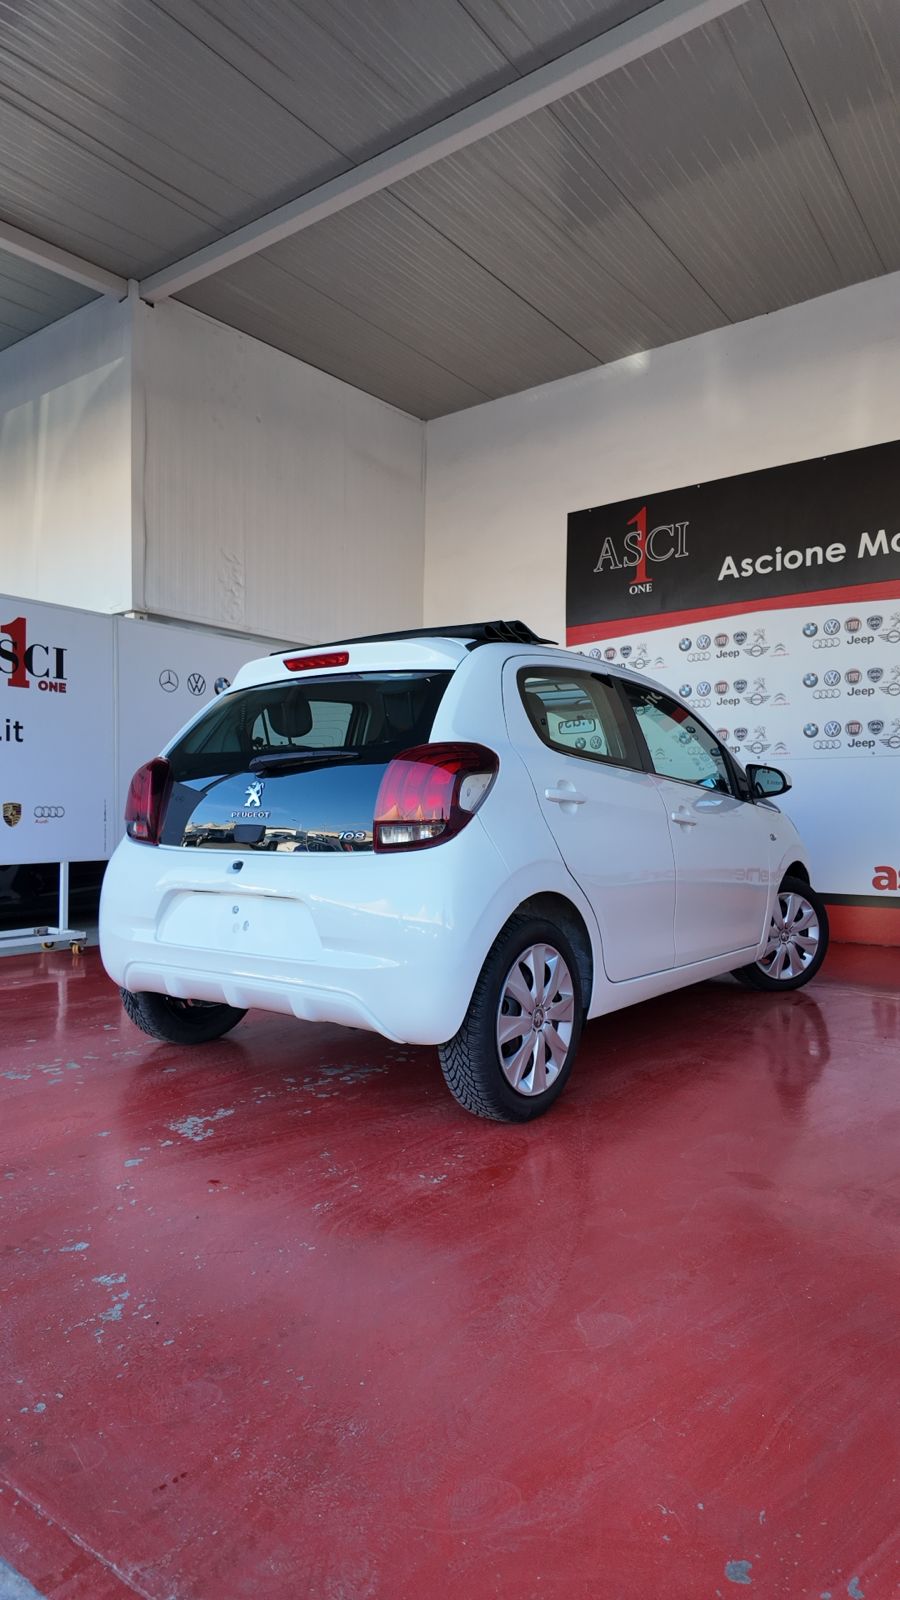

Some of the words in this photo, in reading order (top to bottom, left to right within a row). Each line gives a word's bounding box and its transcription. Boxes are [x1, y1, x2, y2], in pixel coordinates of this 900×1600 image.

[718, 542, 847, 581] Ascione
[629, 583, 653, 595] ONE
[846, 635, 875, 645] Jeep
[716, 650, 740, 659] Jeep
[38, 680, 67, 693] ONE
[847, 687, 875, 697] Jeep
[716, 697, 740, 707] Jeep
[847, 738, 876, 749] Jeep
[231, 811, 271, 819] PEUGEOT
[338, 831, 366, 841] 108
[871, 865, 900, 891] a
